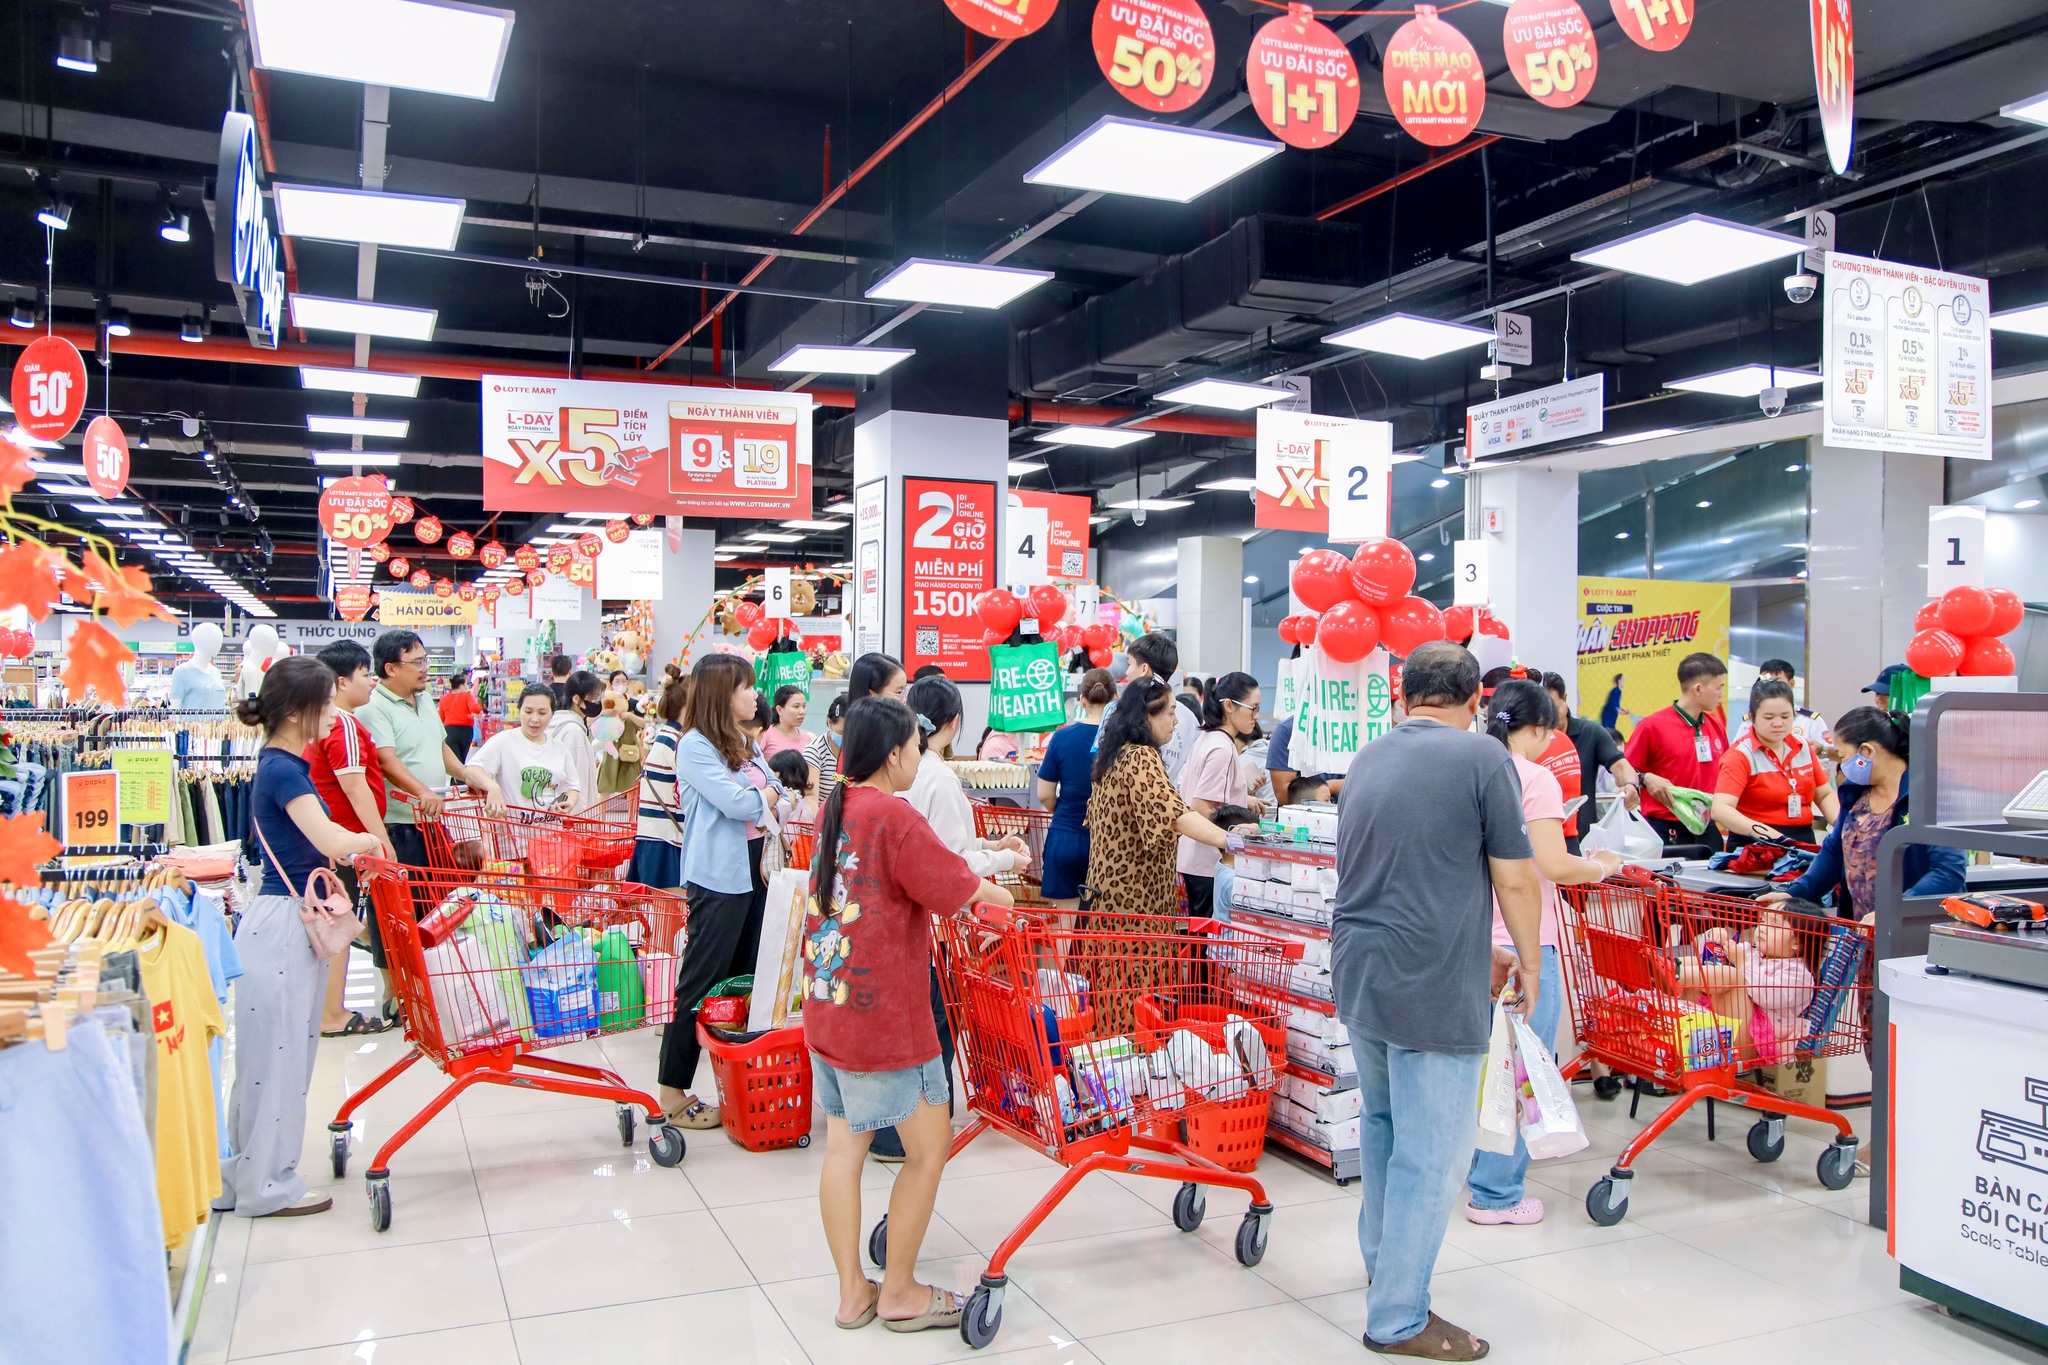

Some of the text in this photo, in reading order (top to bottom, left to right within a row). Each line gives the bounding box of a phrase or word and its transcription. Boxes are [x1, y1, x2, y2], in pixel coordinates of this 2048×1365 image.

[1111, 4, 1138, 26] ƯU
[1140, 14, 1170, 37] ĐÃI
[1135, 29, 1177, 50] Giảm đến
[1513, 29, 1533, 44] ƯU
[1534, 21, 1557, 40] ĐÃI
[1261, 37, 1345, 59] LOTTE MART PHAN THIẾT
[1552, 37, 1566, 47] đến
[1109, 35, 1202, 97] 50%
[1260, 50, 1283, 68] ƯU
[1285, 53, 1313, 73] ĐÃI
[1391, 49, 1472, 73] DIỆN MẠO
[1525, 42, 1594, 97] 50%
[1402, 70, 1469, 115] MỚI
[1265, 70, 1340, 134] 1+1
[1832, 260, 1861, 272] CHƯƠNG
[1862, 264, 1882, 275] TRÌNH
[1882, 267, 1904, 280] THÀNH
[1904, 271, 1919, 282] VIÊN
[1924, 275, 1937, 287] ĐẶC
[1957, 282, 1967, 291] ƯU
[29, 371, 73, 418] 50%
[502, 386, 557, 395] LOTTE MART
[623, 408, 648, 420] ĐIỂM
[687, 404, 779, 420] NGÀY THÀNH VIÊN
[1474, 411, 1488, 422] QUẦY
[1490, 407, 1508, 417] THANH
[1509, 402, 1525, 412] TOÁN
[1526, 398, 1540, 408] ĐIỆN
[508, 412, 554, 426] L-DAY
[623, 419, 647, 431] TÍCH
[623, 432, 643, 442] LŨY
[1487, 436, 1501, 445] VISA
[692, 437, 780, 474] 9 & 19
[1276, 443, 1311, 455] L-DAY
[96, 443, 123, 482] 50%
[1347, 465, 1368, 501] 2
[329, 498, 344, 506] ƯU
[346, 496, 365, 507] ĐÃI
[730, 501, 790, 509] WWW.LOTTEMART.VN
[959, 502, 975, 510] CHỢ
[389, 505, 408, 522] 1+1
[913, 491, 954, 549] 2
[959, 510, 984, 518] ONLINE
[332, 513, 389, 540] 50%
[417, 526, 436, 540] MỚI
[1054, 529, 1072, 538] CHỢ
[610, 529, 627, 541] MỚI
[1053, 538, 1081, 547] ONLINE
[450, 545, 471, 556] 50%
[583, 542, 600, 556] 1+1
[969, 537, 985, 550] CÓ
[1018, 534, 1035, 558] 4
[1946, 537, 1966, 566] 1
[484, 553, 502, 565] 1+1
[518, 556, 536, 566] MỚI
[552, 553, 571, 566] 50%
[914, 557, 983, 577] MIỄN PHÍ
[391, 564, 405, 577] 1+1
[1465, 563, 1477, 582] 3
[530, 576, 544, 586] 1+1
[929, 581, 946, 589] HÀNG
[461, 591, 474, 600] 1+1
[772, 585, 783, 600] 6
[396, 603, 462, 616] HÀN QUỐC
[913, 590, 985, 617] 150K
[1080, 600, 1086, 614] 7
[1596, 604, 1623, 614] CUỘC THI
[297, 622, 335, 638] THỨC
[1610, 610, 1700, 651] SHOPPING
[1587, 655, 1609, 665] LOTTE
[1610, 653, 1630, 662] MART
[1632, 651, 1651, 660] PHAN
[1652, 648, 1671, 657] THIẾT
[998, 666, 1027, 691] RE:
[1002, 690, 1061, 718] EARTH
[76, 809, 109, 829] 199
[1975, 1175, 2020, 1206] BÀN
[1961, 1198, 1999, 1227] ĐỐI
[1960, 1223, 2002, 1250] Scale
